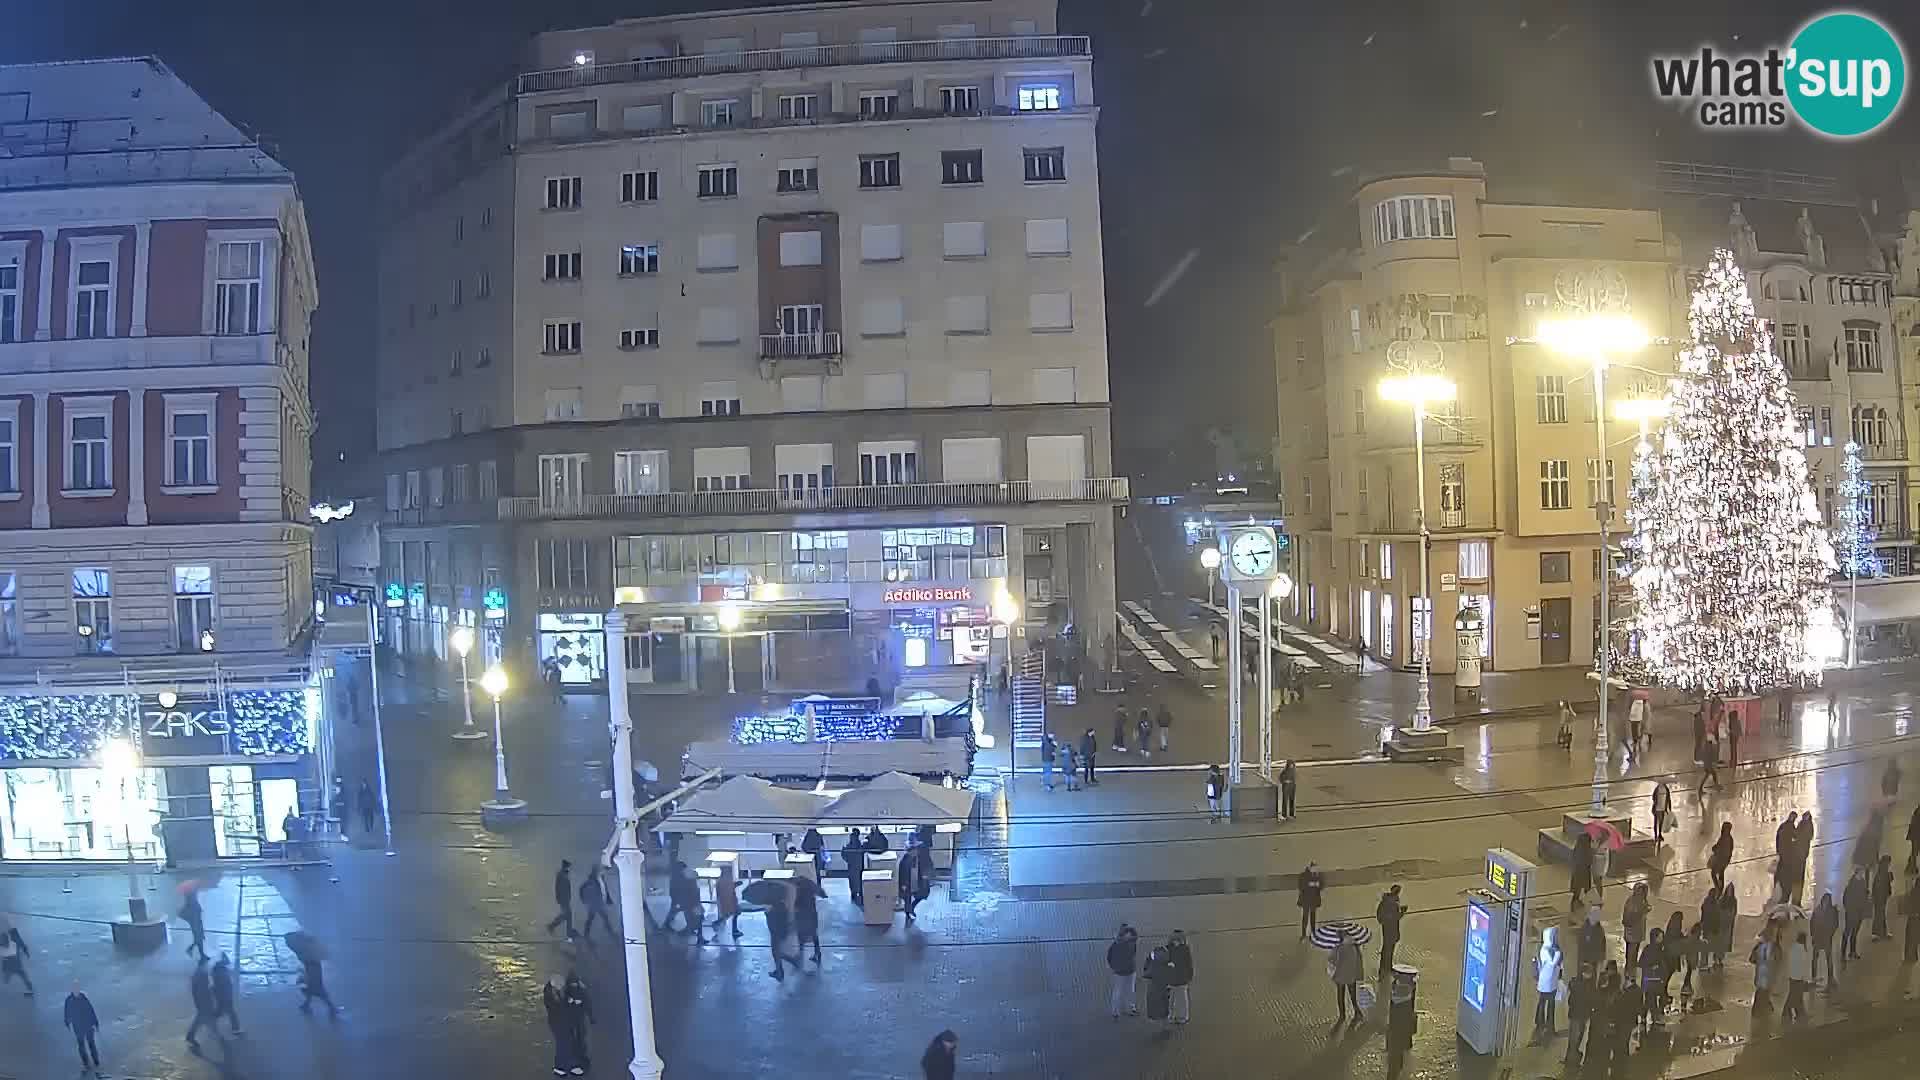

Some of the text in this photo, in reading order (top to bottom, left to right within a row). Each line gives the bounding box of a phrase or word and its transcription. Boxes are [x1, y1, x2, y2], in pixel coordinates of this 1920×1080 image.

[884, 586, 971, 602] Addiko Bank
[144, 711, 232, 737] ZAKS
